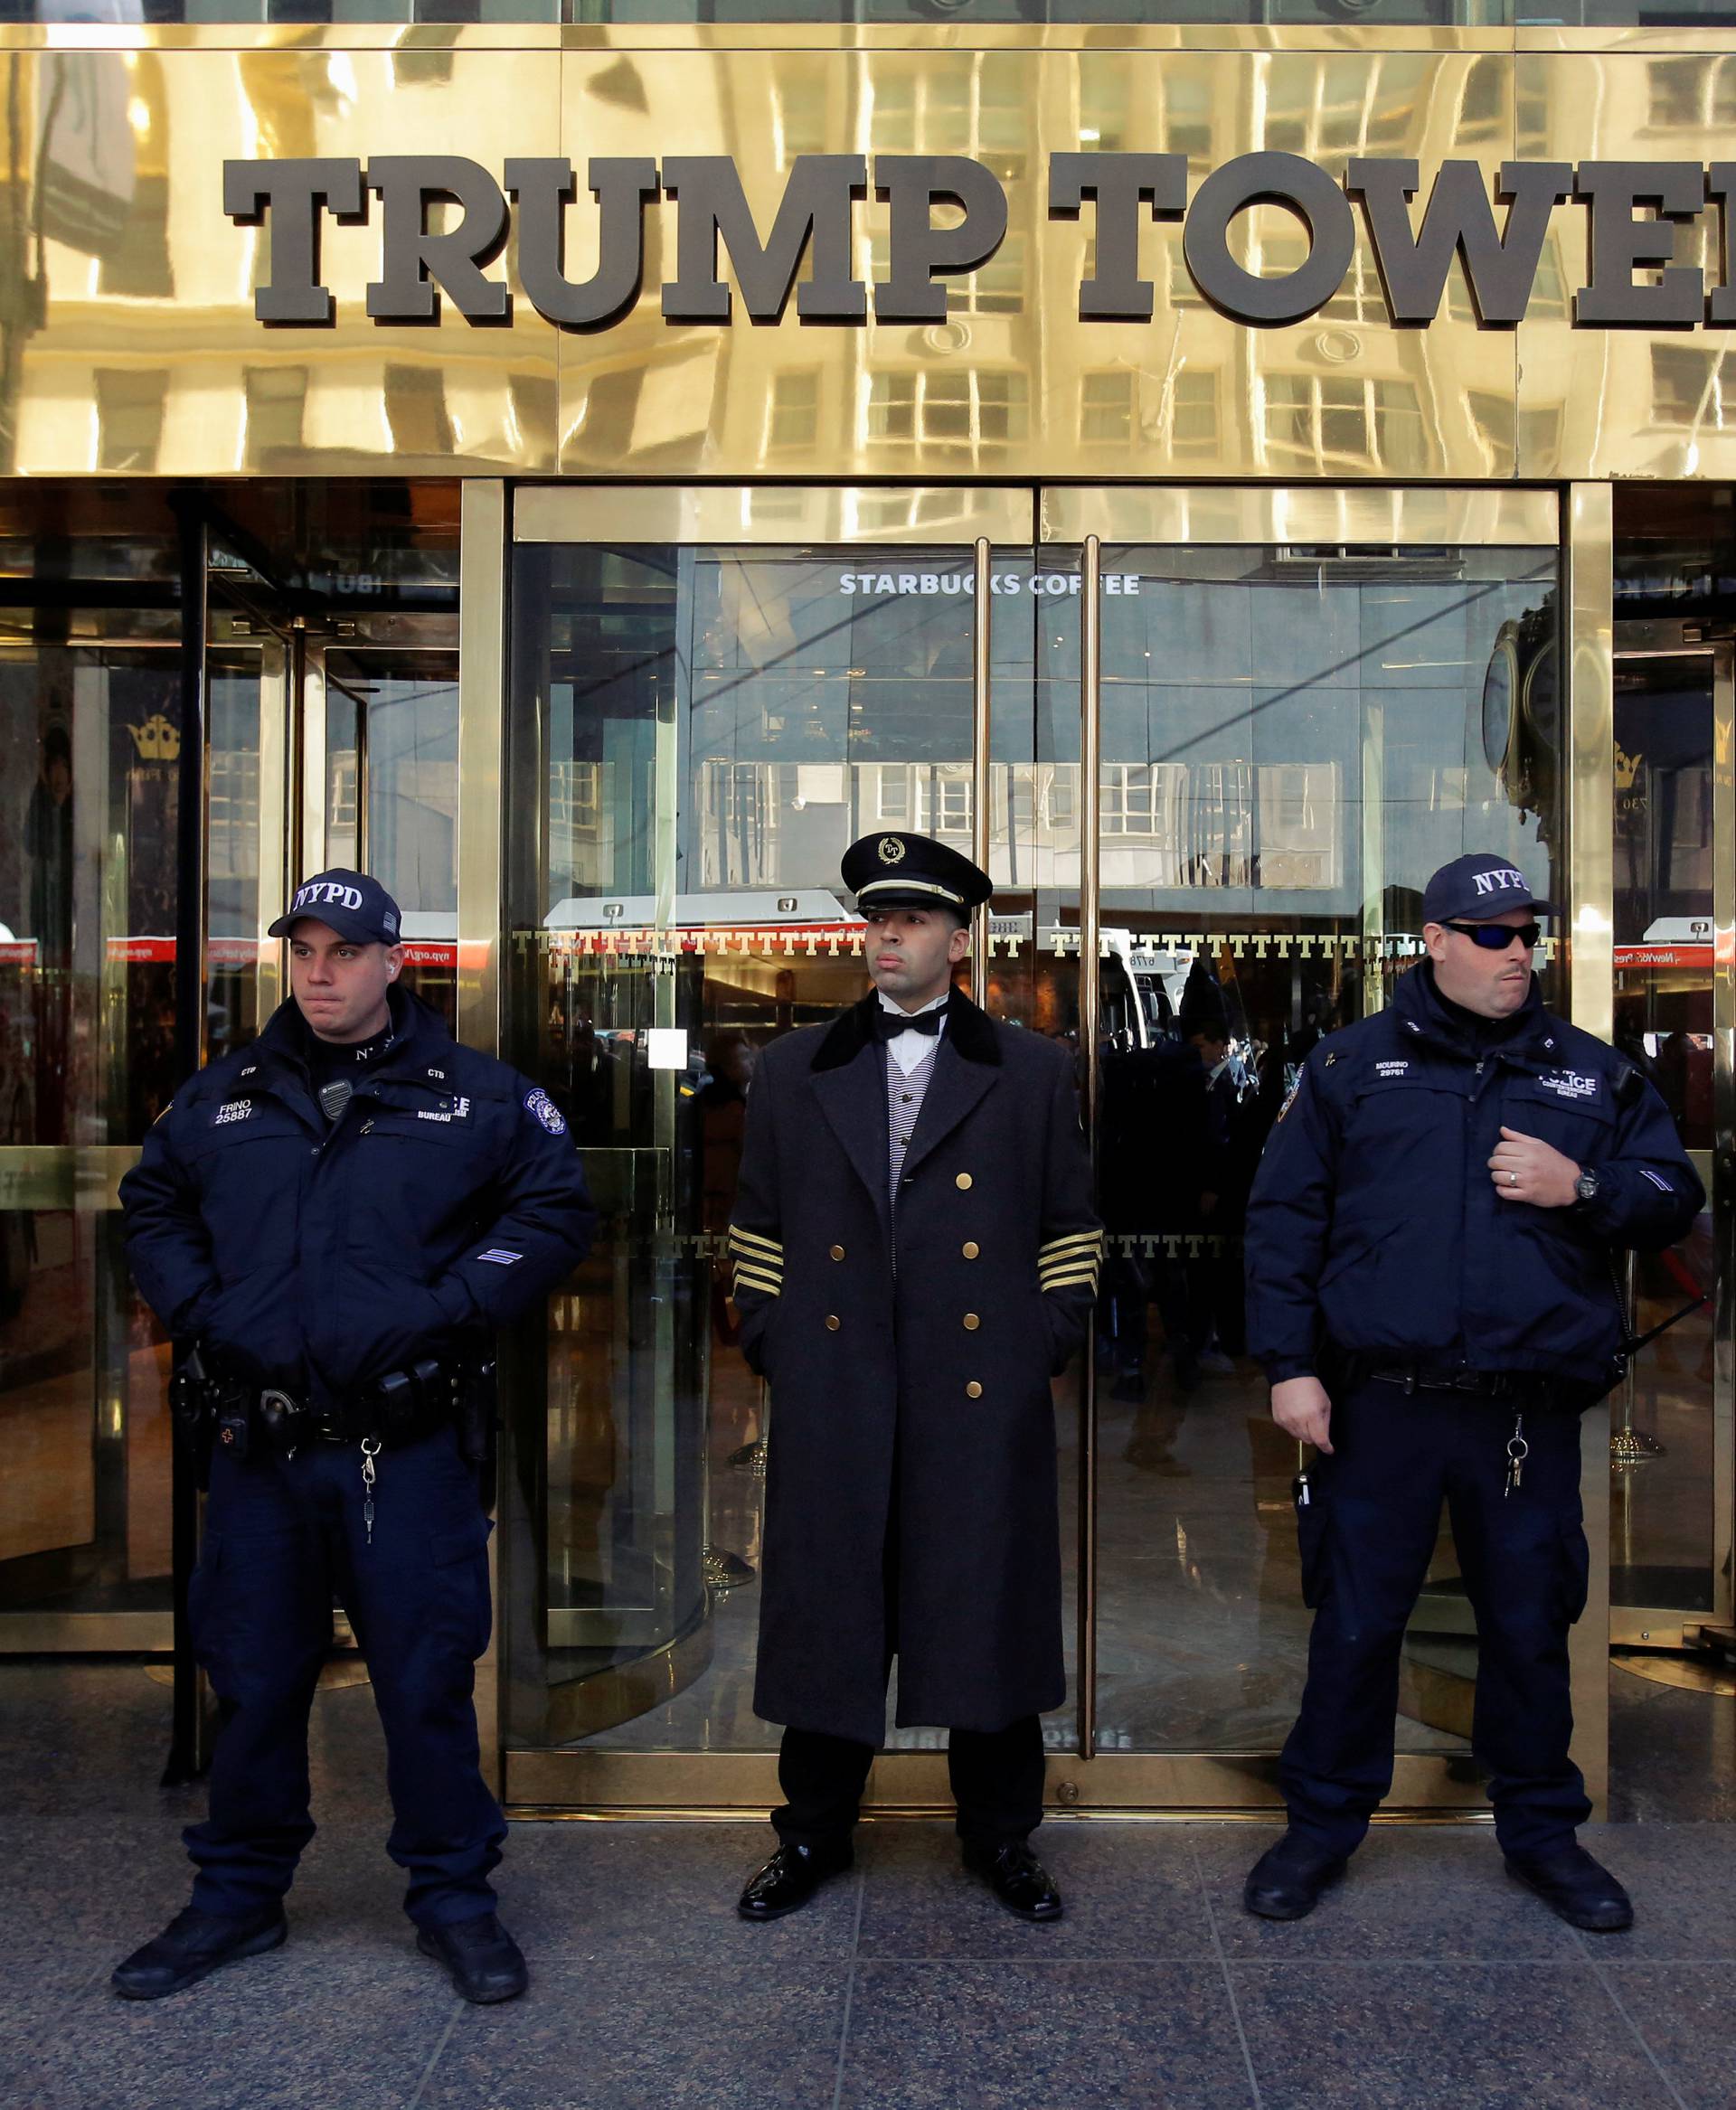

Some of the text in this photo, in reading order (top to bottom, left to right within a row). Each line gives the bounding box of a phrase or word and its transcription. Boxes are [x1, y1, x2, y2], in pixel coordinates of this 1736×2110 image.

[223, 151, 1736, 329] TRUMP TOWE
[1028, 573, 1139, 595] COFEE
[293, 882, 363, 912] NYPD
[427, 1069, 445, 1079] CTB
[214, 1107, 252, 1125] 25887
[219, 1099, 251, 1115] FRINO
[417, 1110, 451, 1123] BUREAU
